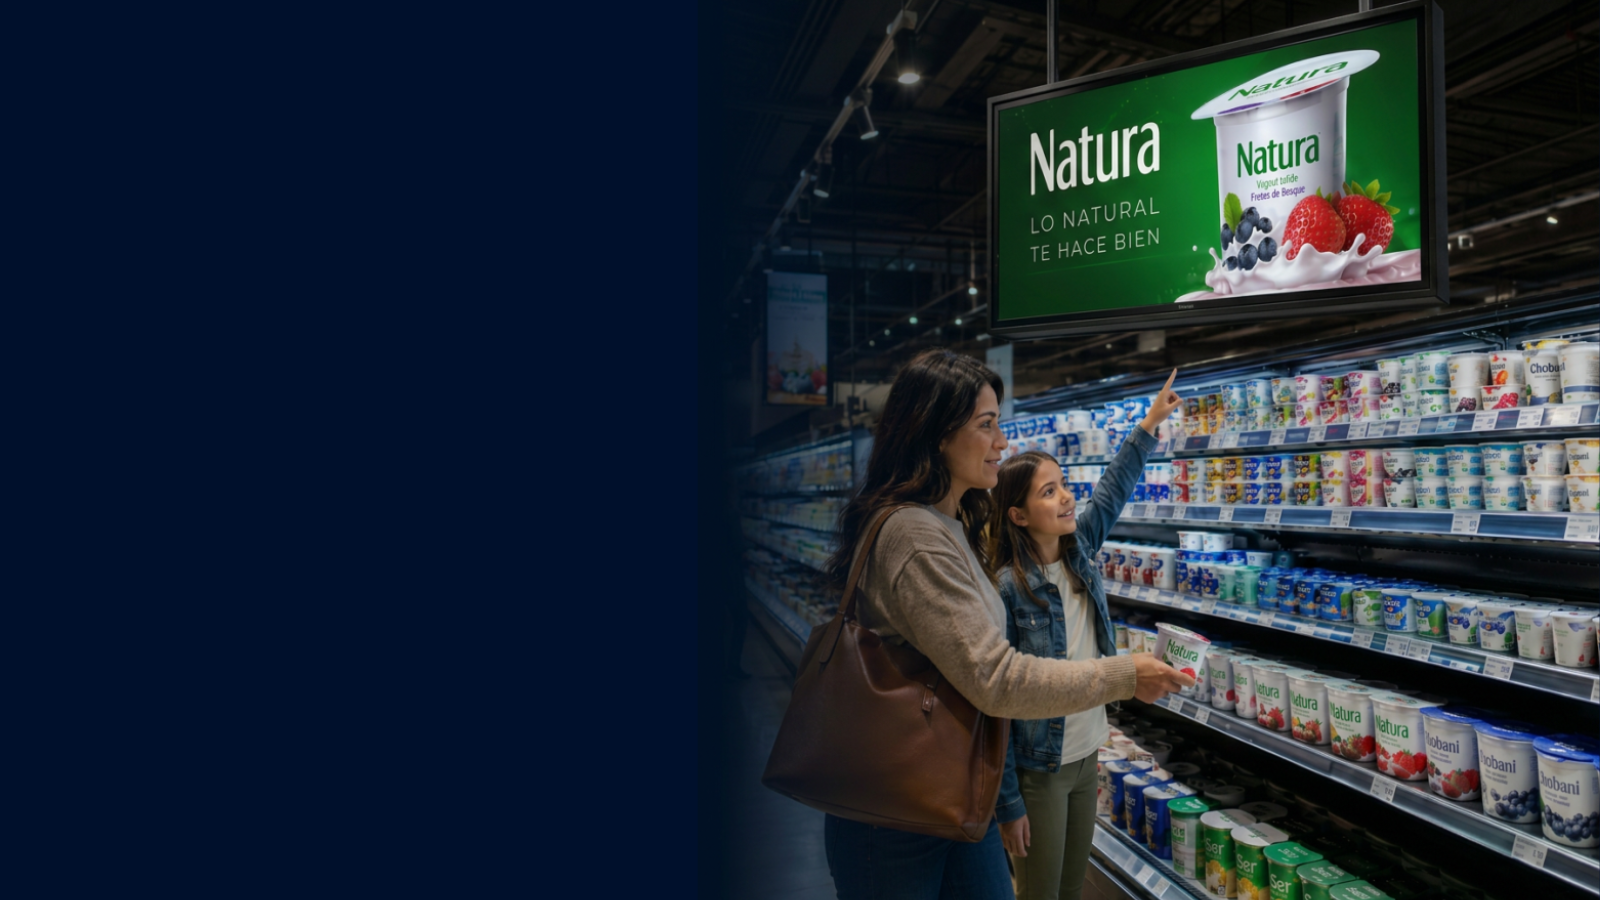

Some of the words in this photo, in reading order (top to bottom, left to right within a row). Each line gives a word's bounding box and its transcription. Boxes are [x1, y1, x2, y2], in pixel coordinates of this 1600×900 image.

[1228, 61, 1348, 101] Natura
[1030, 122, 1160, 196] Natura
[1237, 134, 1319, 178] Natura
[1271, 188, 1280, 199] de
[1031, 216, 1054, 235] LO
[1063, 197, 1160, 229] NATURAL
[1030, 244, 1050, 262] TE
[1058, 236, 1106, 259] HACE
[1115, 227, 1160, 250] BIEN
[1166, 638, 1199, 662] Natura
[1329, 701, 1361, 723] Natura
[1375, 714, 1409, 739] Natura
[1236, 853, 1257, 874] Ser
[1270, 873, 1292, 894] Ser
